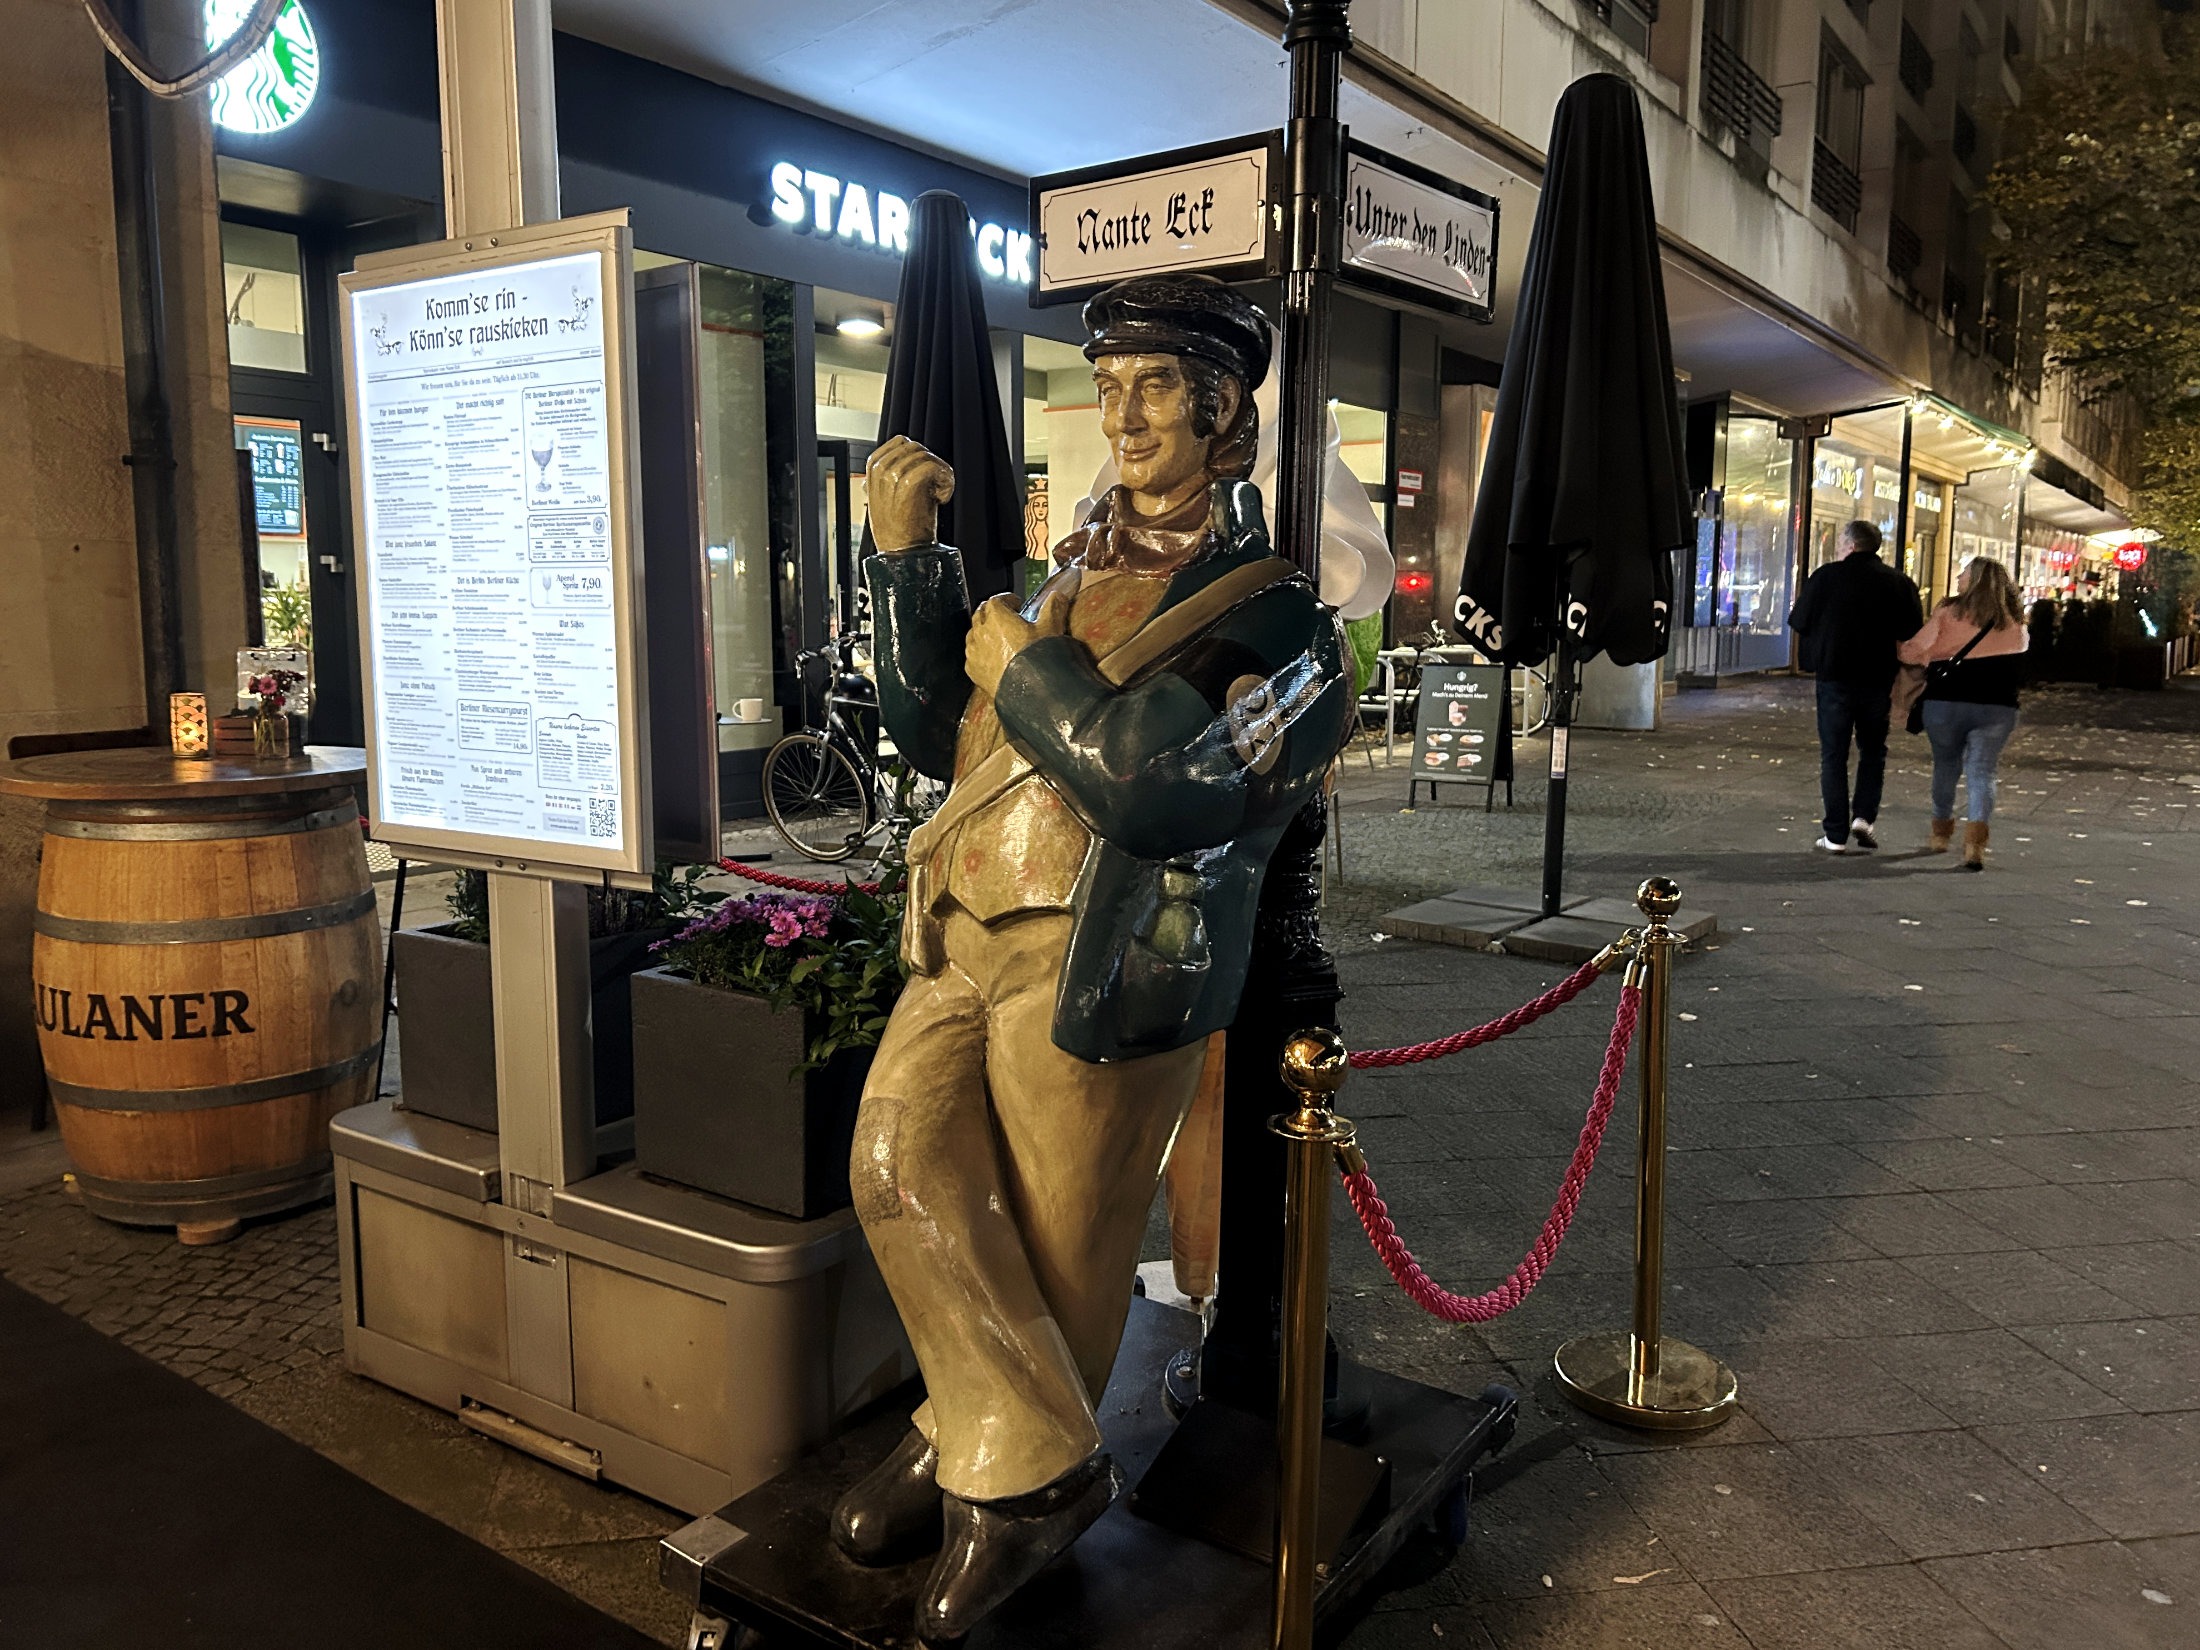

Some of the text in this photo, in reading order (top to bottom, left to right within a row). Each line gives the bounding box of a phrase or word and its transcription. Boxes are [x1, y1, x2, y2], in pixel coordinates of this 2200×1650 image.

[770, 160, 1033, 285] STARCK
[1077, 187, 1214, 255] Nante Eck
[1355, 184, 1487, 278] Unter den Linden
[425, 292, 489, 321] Komm'se
[495, 288, 516, 311] rin
[409, 316, 549, 352] Könn'se rauskieken
[556, 573, 575, 584] Aperol
[562, 582, 579, 591] Spritz
[581, 577, 601, 591] 7,90
[1443, 682, 1478, 693] Hungrig?
[460, 703, 480, 713] Berliner
[36, 984, 256, 1041] ULANER
